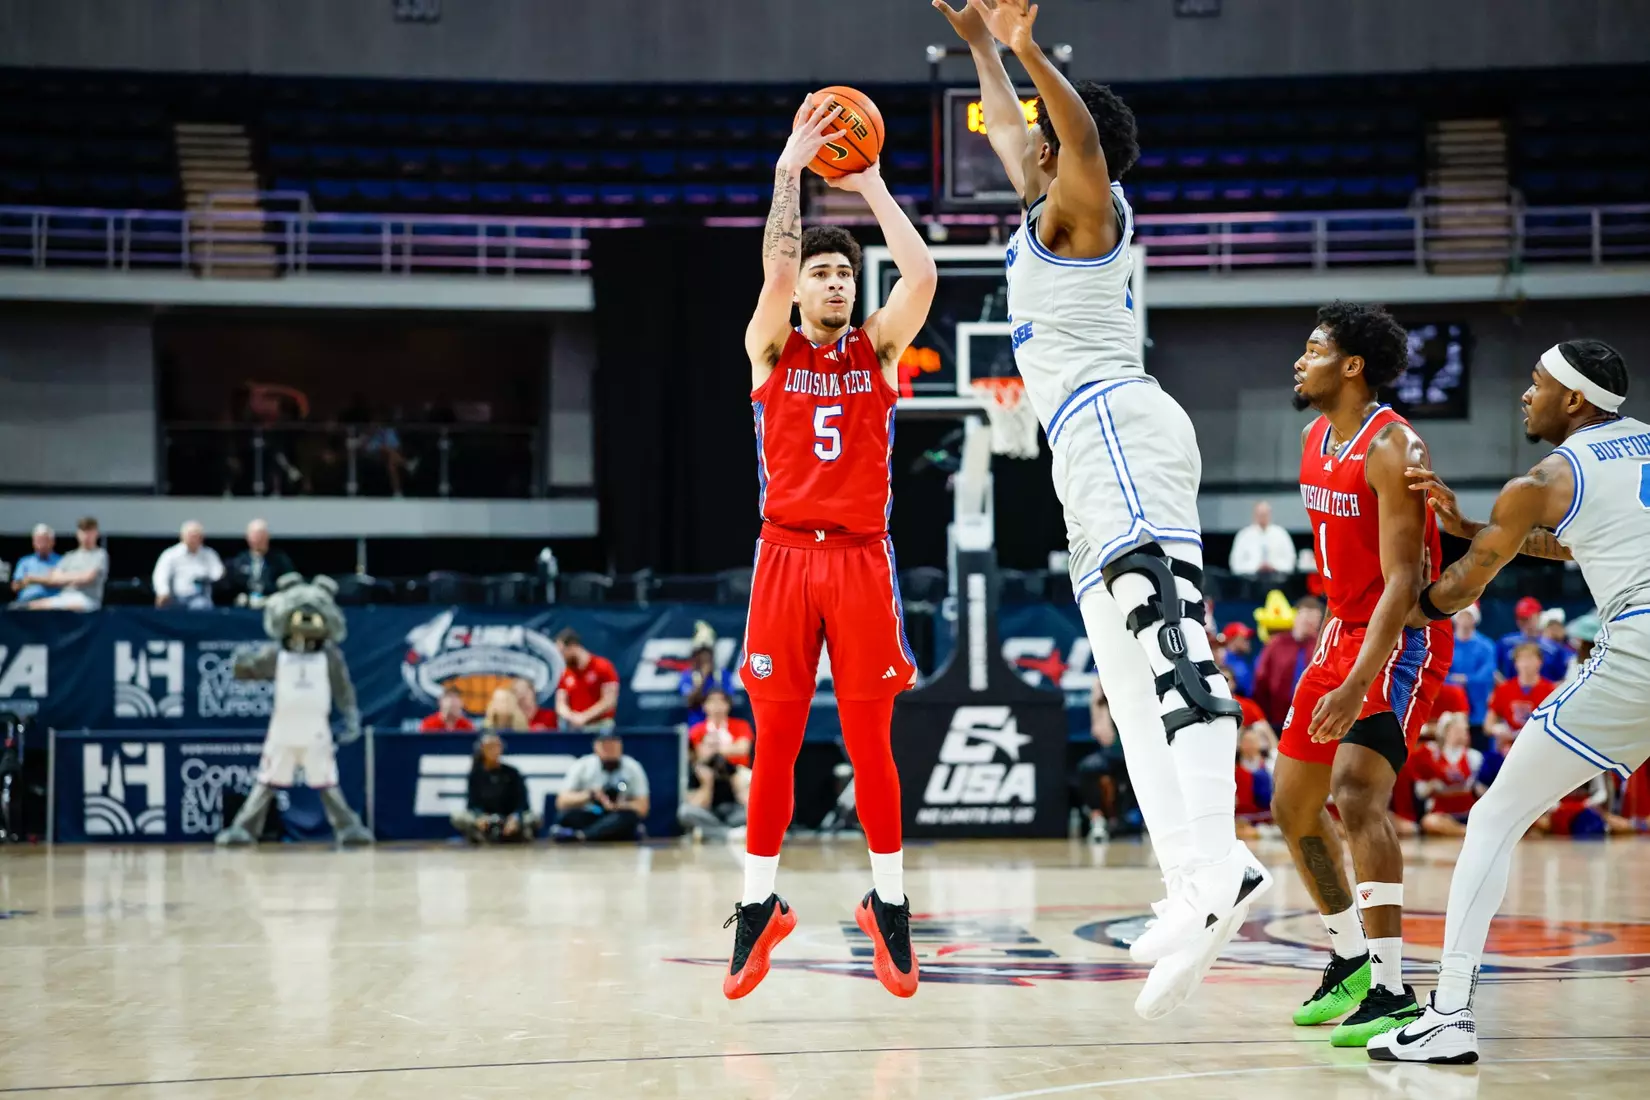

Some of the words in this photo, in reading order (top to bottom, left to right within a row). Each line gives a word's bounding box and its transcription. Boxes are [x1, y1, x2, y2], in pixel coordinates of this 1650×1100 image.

[1012, 321, 1034, 350] SEE
[843, 369, 872, 395] TECH
[813, 404, 843, 461] 5
[1586, 432, 1650, 462] BUFFOR
[1331, 490, 1360, 518] TECH
[1318, 521, 1333, 580] 1
[0, 644, 48, 698] A
[923, 763, 1037, 805] USA
